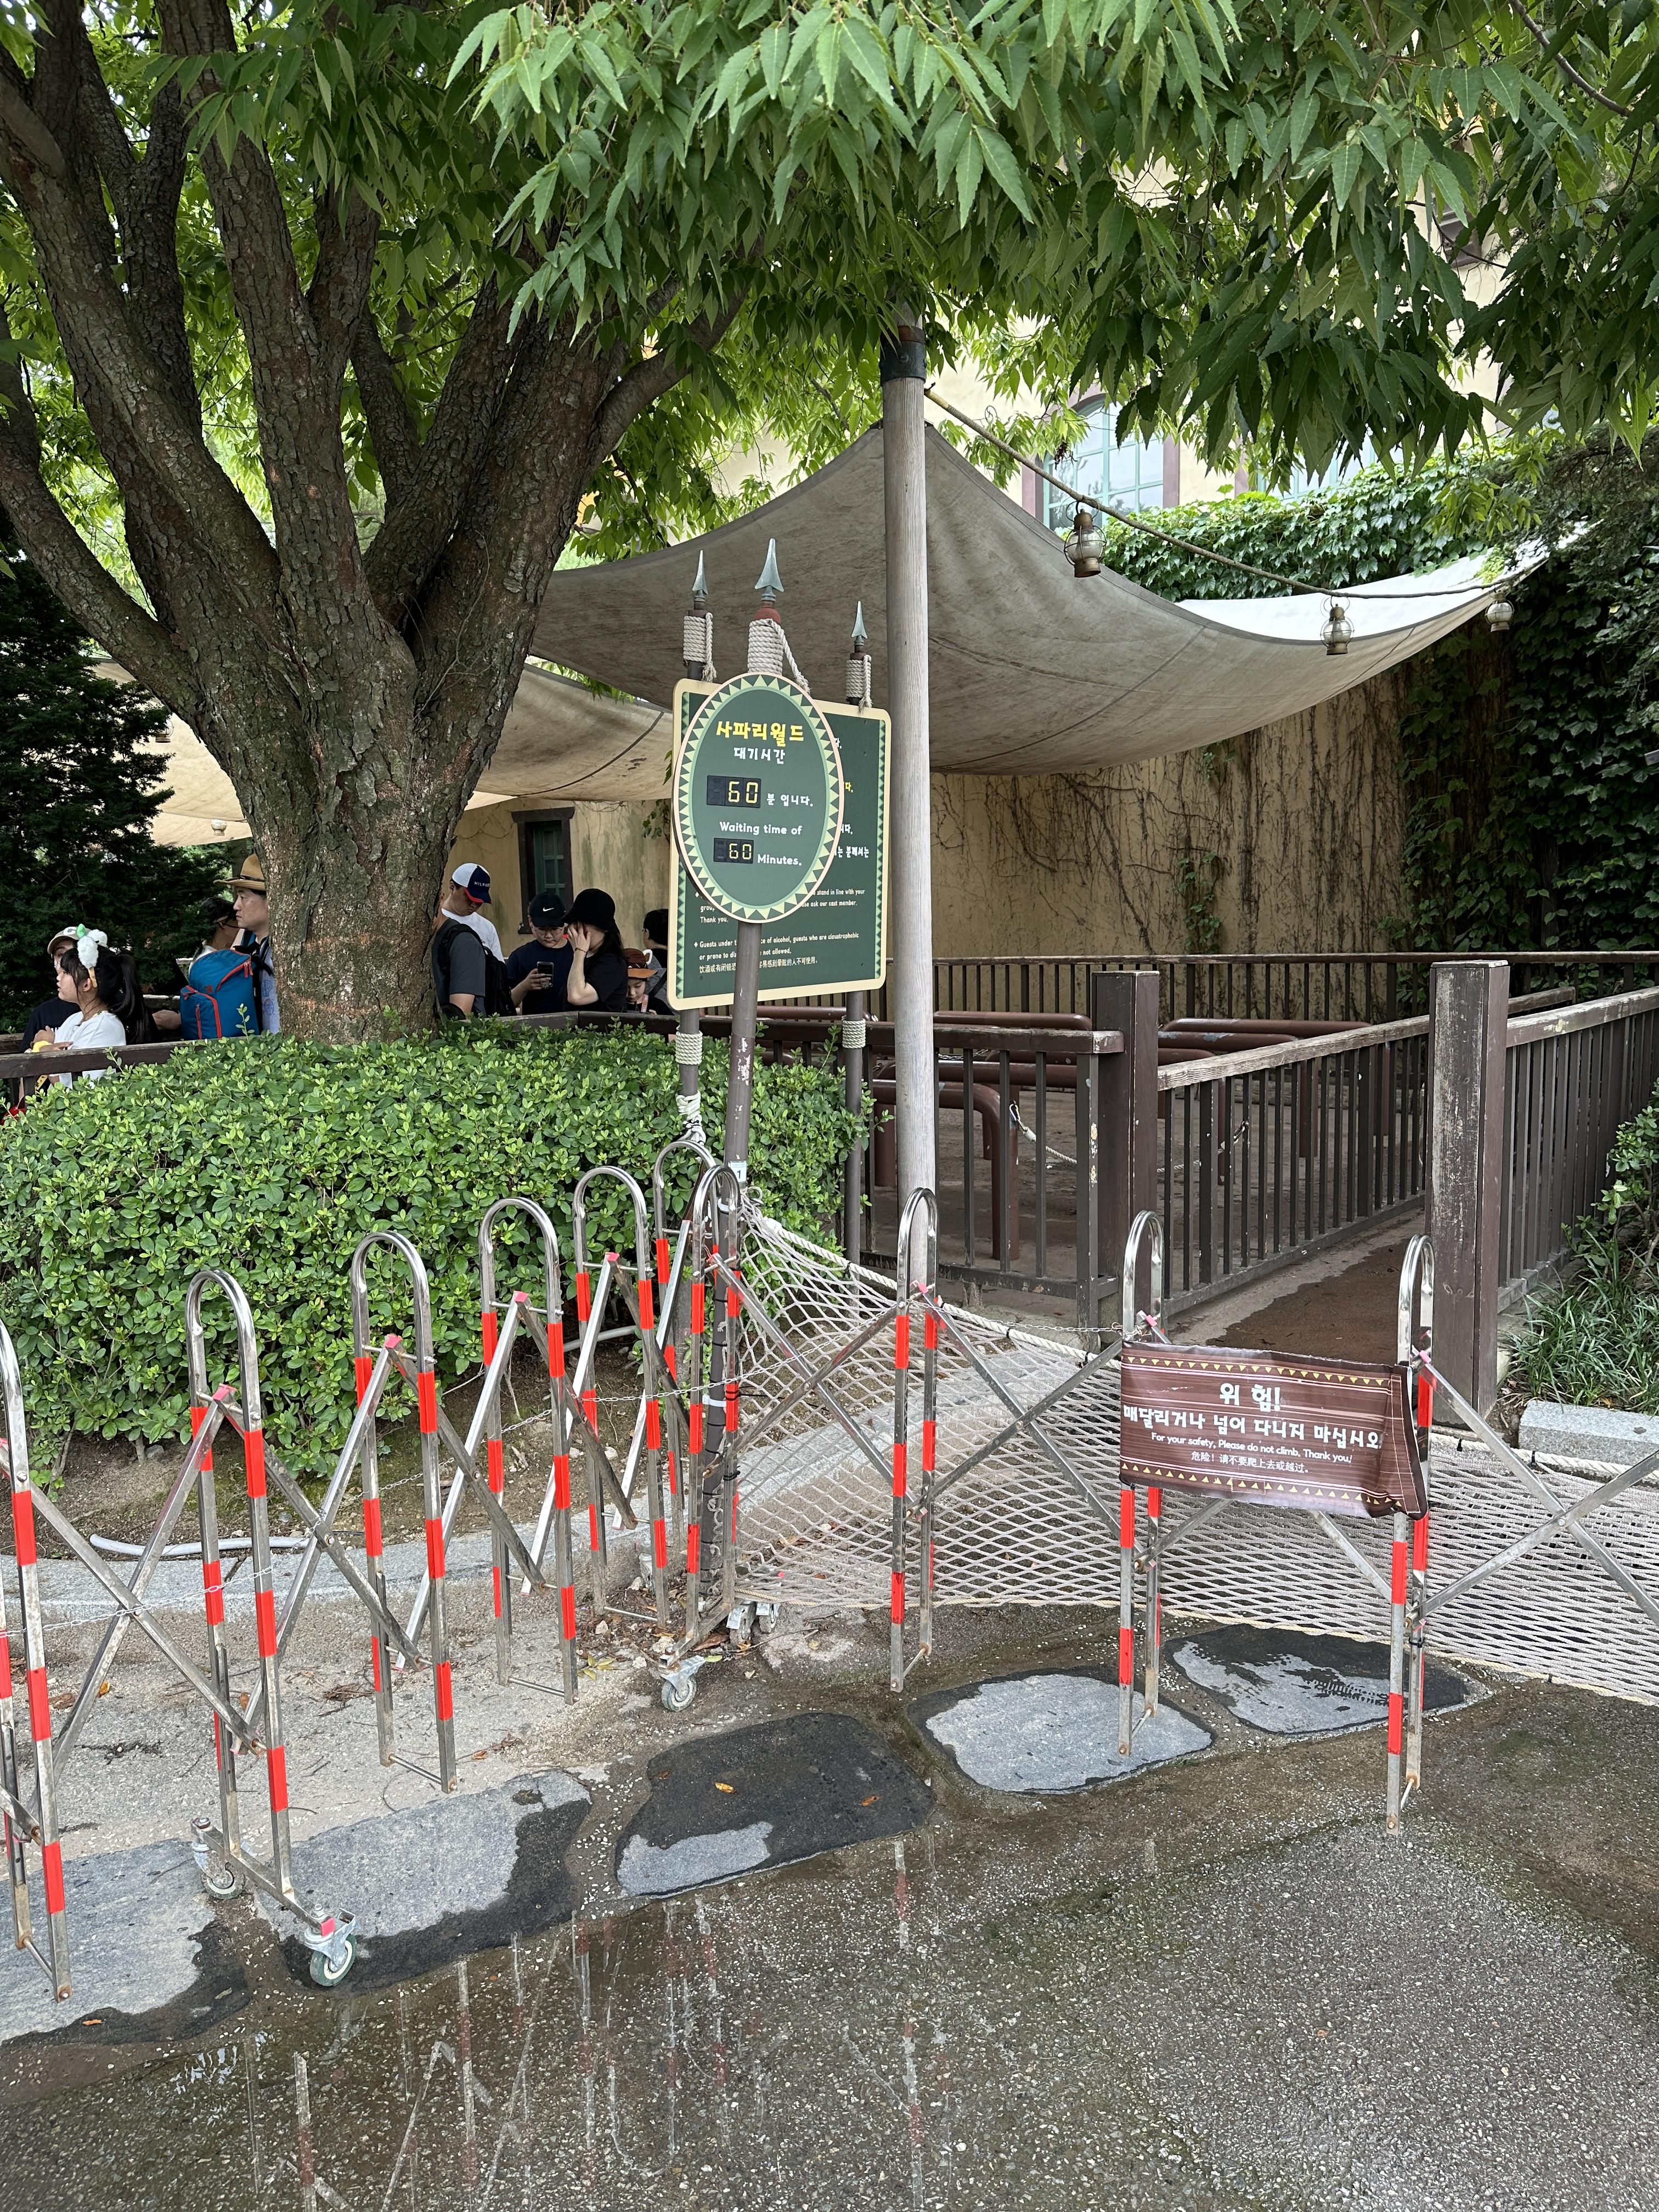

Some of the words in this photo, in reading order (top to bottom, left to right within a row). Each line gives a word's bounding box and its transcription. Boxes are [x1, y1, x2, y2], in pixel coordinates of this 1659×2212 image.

[716, 720, 804, 747] 사파리월드
[733, 747, 786, 765] 대기시간
[728, 781, 759, 804] 60
[766, 793, 775, 806] 분
[780, 794, 814, 807] 입니다.
[719, 821, 760, 836] Waiting
[763, 824, 787, 834] time
[791, 825, 803, 835] of
[729, 843, 752, 860] 60
[757, 854, 802, 866] Minutes.
[718, 916, 729, 924] you.
[773, 935, 792, 944] alcohol,
[793, 935, 808, 944] guests
[707, 953, 722, 962] prone
[772, 946, 792, 955] allowed.
[736, 1169, 742, 1179] 1
[1219, 1382, 1240, 1406] 위
[1251, 1384, 1281, 1413] 험!
[1123, 1404, 1206, 1430] 매달리거나
[1213, 1414, 1246, 1436] 넘어
[1254, 1419, 1305, 1441] 다니지
[1151, 1431, 1166, 1441] For
[1166, 1436, 1186, 1445] your
[1187, 1437, 1217, 1449] safety,
[1218, 1438, 1245, 1451] Please
[1246, 1442, 1259, 1452] do
[1260, 1445, 1274, 1454] not
[1276, 1446, 1301, 1458] climb.
[1302, 1448, 1331, 1461] Thank
